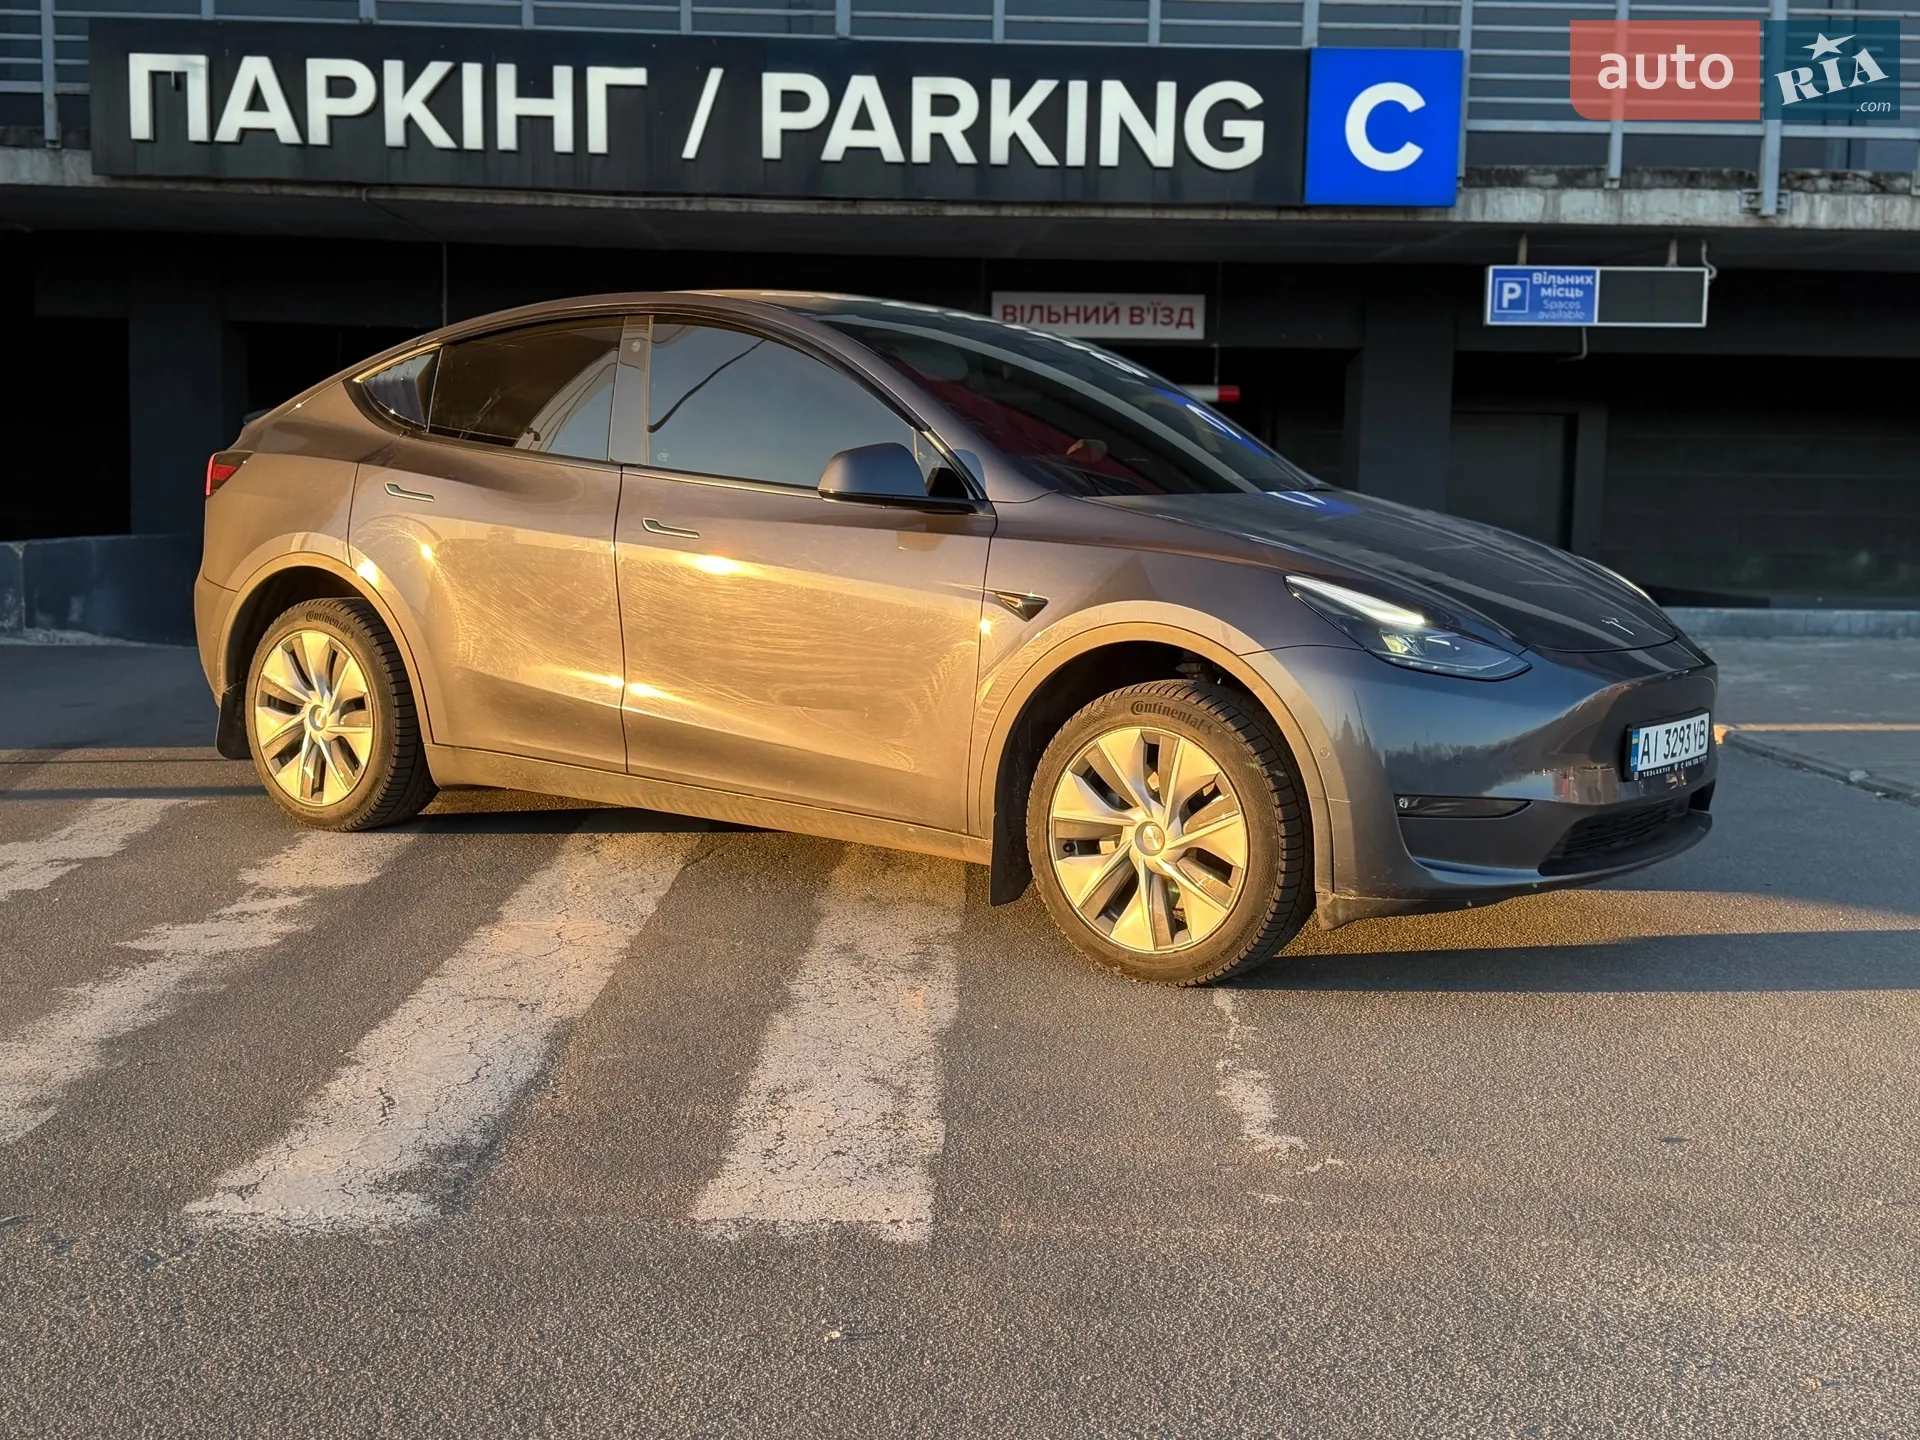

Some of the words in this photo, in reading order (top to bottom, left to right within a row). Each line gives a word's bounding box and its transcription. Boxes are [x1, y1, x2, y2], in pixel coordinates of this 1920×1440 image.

[128, 53, 649, 154] ПАРКІНГ
[681, 67, 724, 160] /
[761, 71, 1265, 171] PARKING
[1532, 271, 1594, 286] Вільних
[1540, 284, 1585, 299] місць
[1501, 282, 1522, 309] P
[1542, 300, 1582, 311] Spaces
[1002, 301, 1120, 325] ВІЛЬНИЙ
[1129, 301, 1195, 329] В'ЇЗД
[1538, 309, 1585, 320] available
[305, 610, 351, 636] Continental
[1130, 700, 1203, 731] Continental
[1663, 723, 1692, 760] 3293
